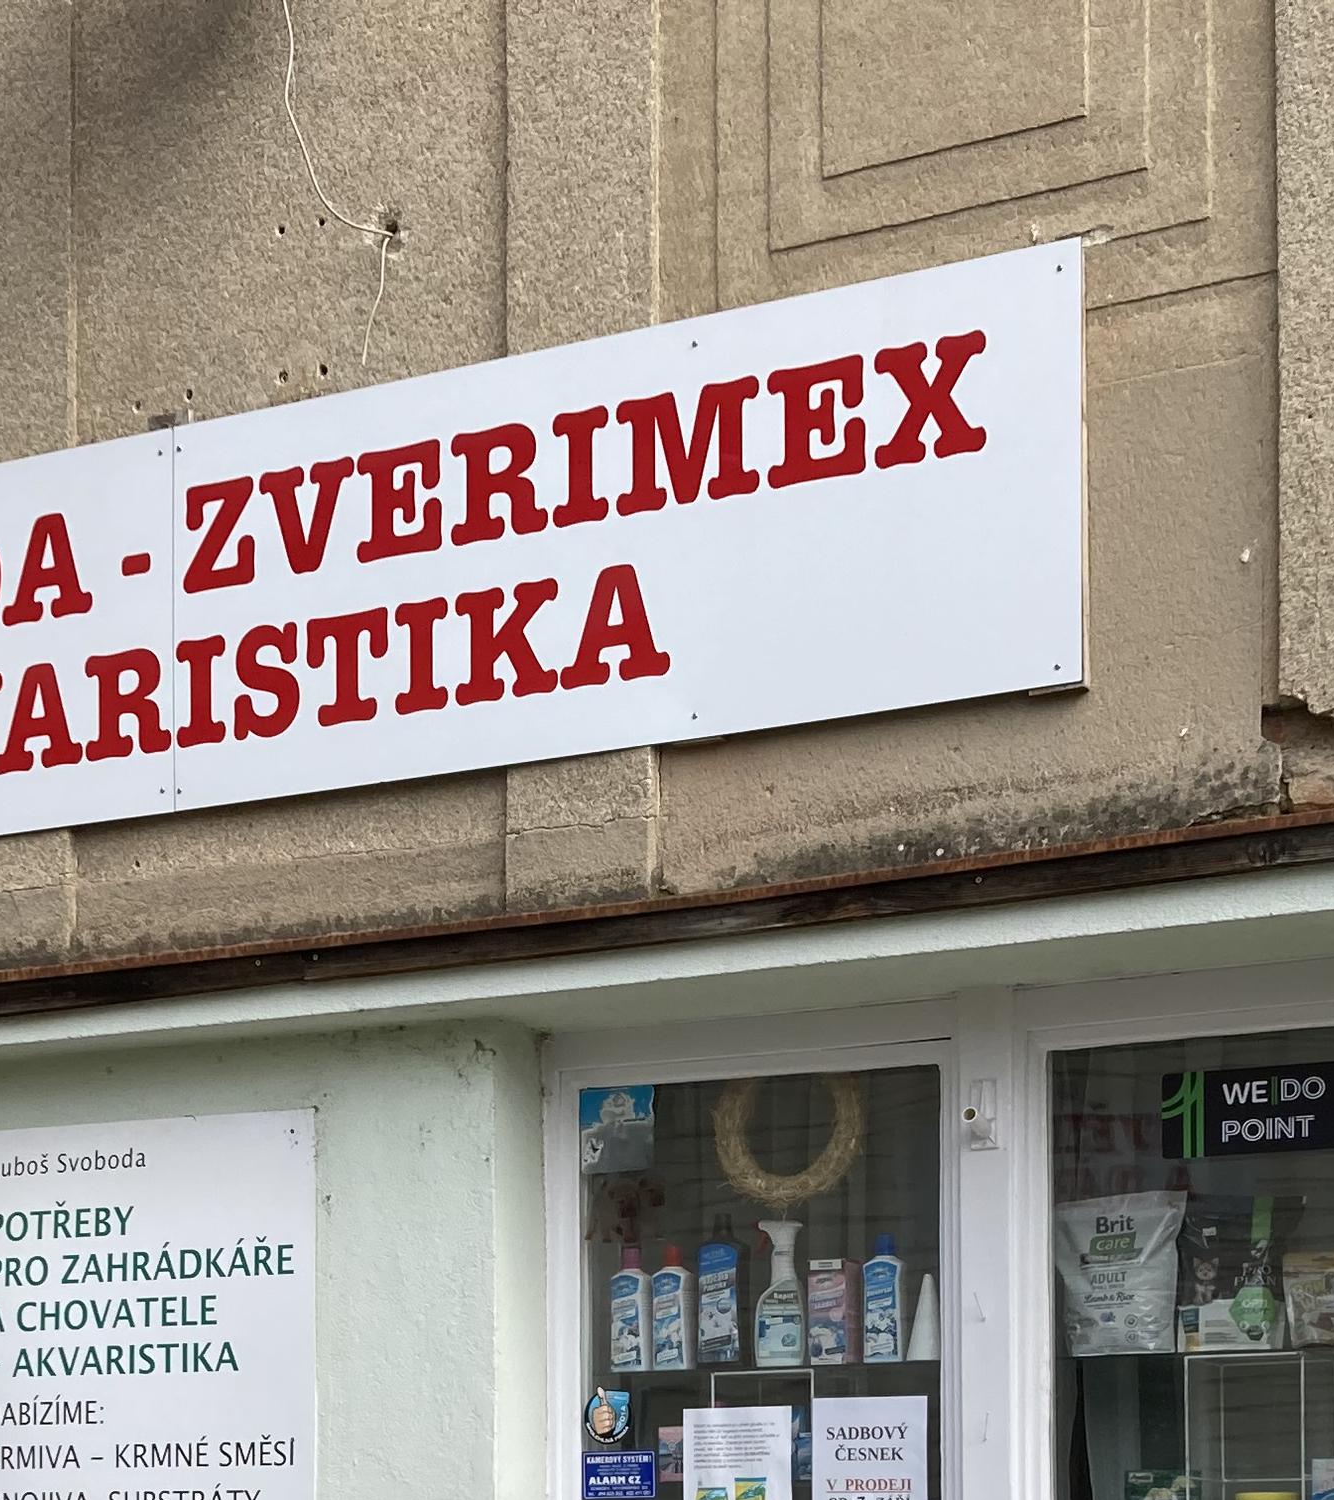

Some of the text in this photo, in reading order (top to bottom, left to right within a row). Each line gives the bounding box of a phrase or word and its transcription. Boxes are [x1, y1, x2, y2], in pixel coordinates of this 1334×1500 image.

[120, 552, 152, 579] -
[183, 329, 989, 597] ZVERIMEX
[1221, 1114, 1315, 1143] POINT
[57, 1148, 147, 1175] Svoboda
[1095, 1214, 1135, 1234] Brit
[1096, 1237, 1130, 1251] care
[61, 1236, 295, 1285] ZAHRÁDKÁŘE
[1090, 1271, 1127, 1285] ADULT
[16, 1294, 217, 1332] CHOVATELE
[12, 1341, 239, 1378] AKVARISTIKA
[826, 1422, 908, 1441] SADBOVÝ
[115, 1436, 209, 1469] KRMNÉ
[218, 1435, 295, 1468] SMĚSÍ
[835, 1444, 904, 1461] ČESNEK
[589, 1476, 625, 1485] ALARM
[826, 1478, 911, 1492] V PRODEJI
